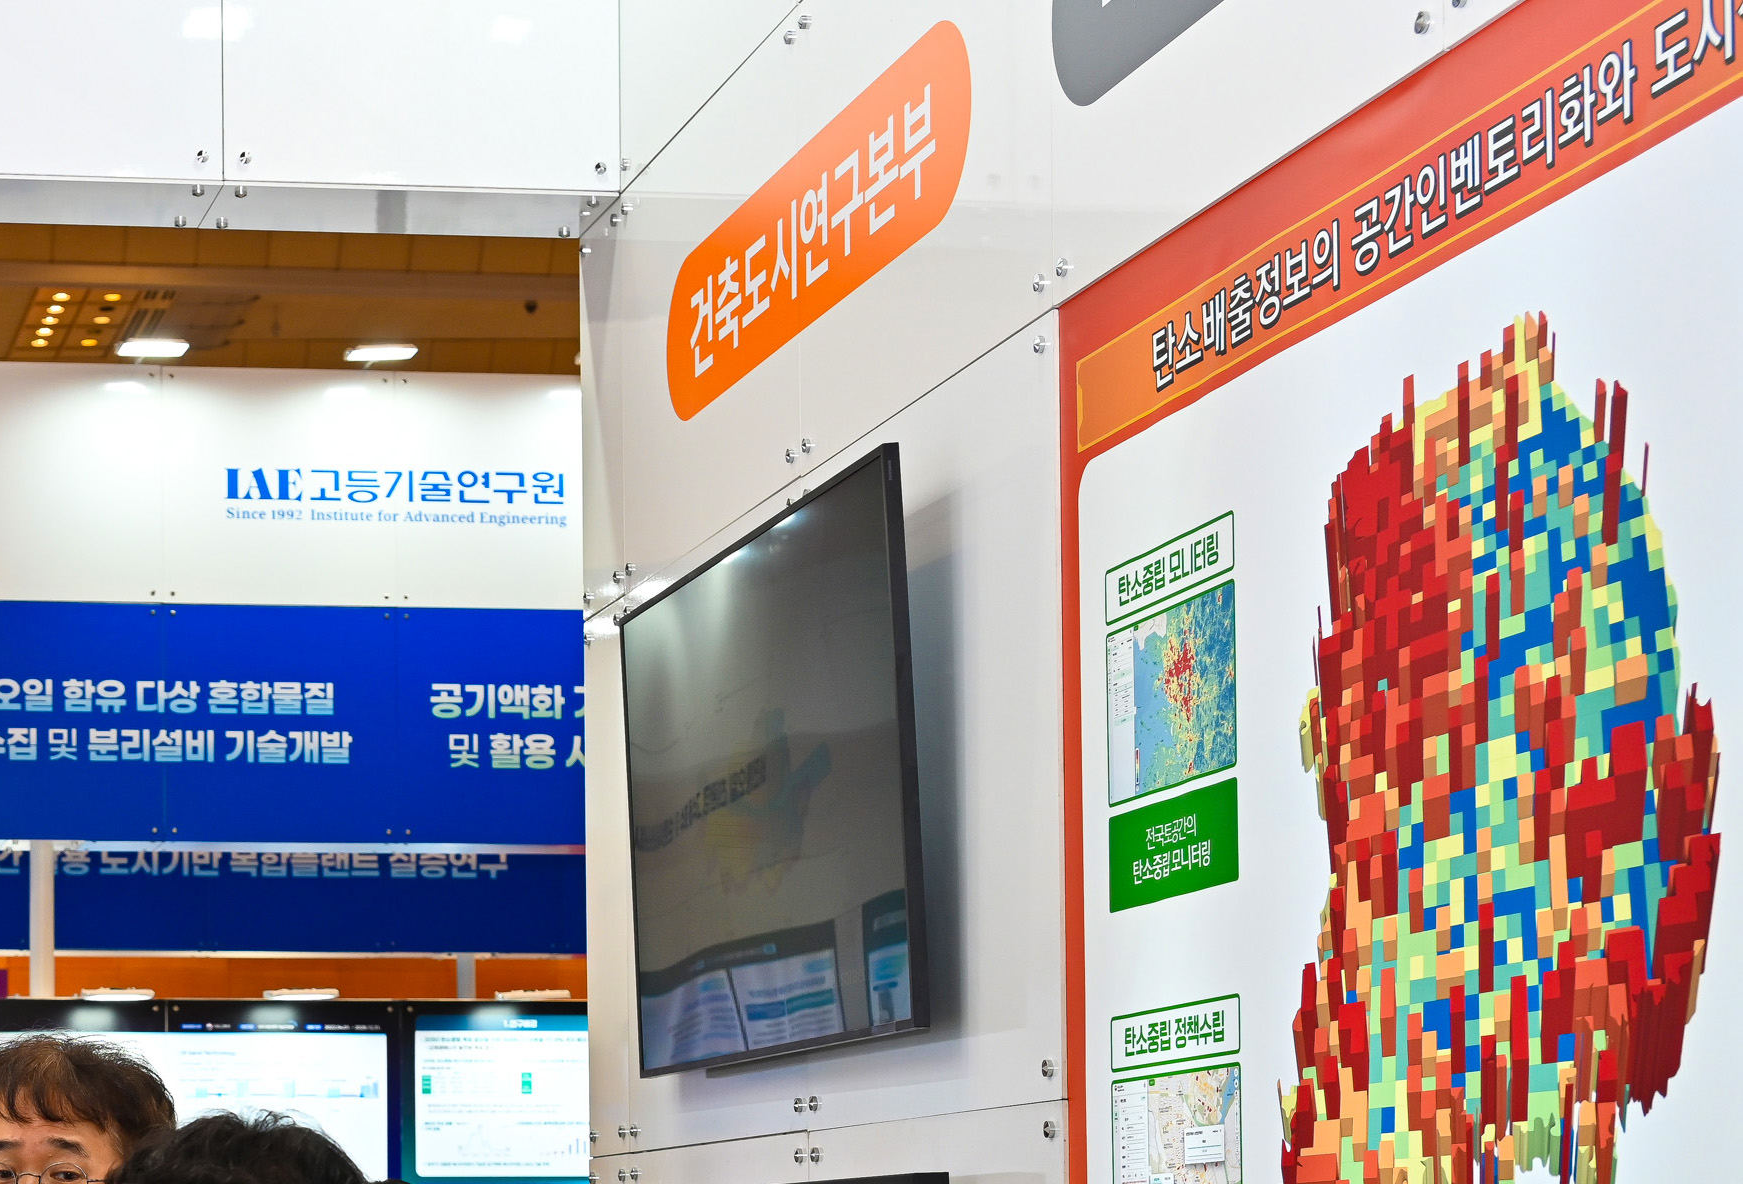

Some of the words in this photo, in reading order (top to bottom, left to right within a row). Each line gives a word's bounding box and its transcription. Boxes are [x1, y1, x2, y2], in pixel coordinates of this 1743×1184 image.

[1150, 219, 1340, 392] 탄소배출정보의
[1350, 40, 1638, 275] 공간인벤토리화와
[1650, 0, 1743, 98] 도시
[690, 83, 936, 378] 건축도시연구본부
[224, 468, 303, 500] IAE
[310, 469, 565, 505] 고등기술연구원
[226, 507, 266, 520] Since
[271, 508, 303, 521] 1992
[310, 508, 373, 523] Institute
[377, 509, 400, 523] for
[403, 510, 475, 525] Advanced
[479, 511, 567, 528] Engineering
[1118, 556, 1166, 607] 탄소중립
[1169, 531, 1219, 584] 모니터링
[62, 677, 127, 714] 함유
[135, 679, 200, 715] 다상
[208, 680, 335, 716] 혼합물질
[429, 682, 565, 721] 공기액화
[48, 728, 79, 762] 및
[87, 728, 215, 763] 분리설비
[225, 728, 352, 765] 기술개발
[448, 734, 479, 769] 및
[488, 732, 557, 770] 활용
[1132, 851, 1171, 885] 탄소중립
[1171, 839, 1211, 872] 모니터링
[1125, 1020, 1171, 1057] 탄소중립
[1175, 1010, 1225, 1049] 정책수립
